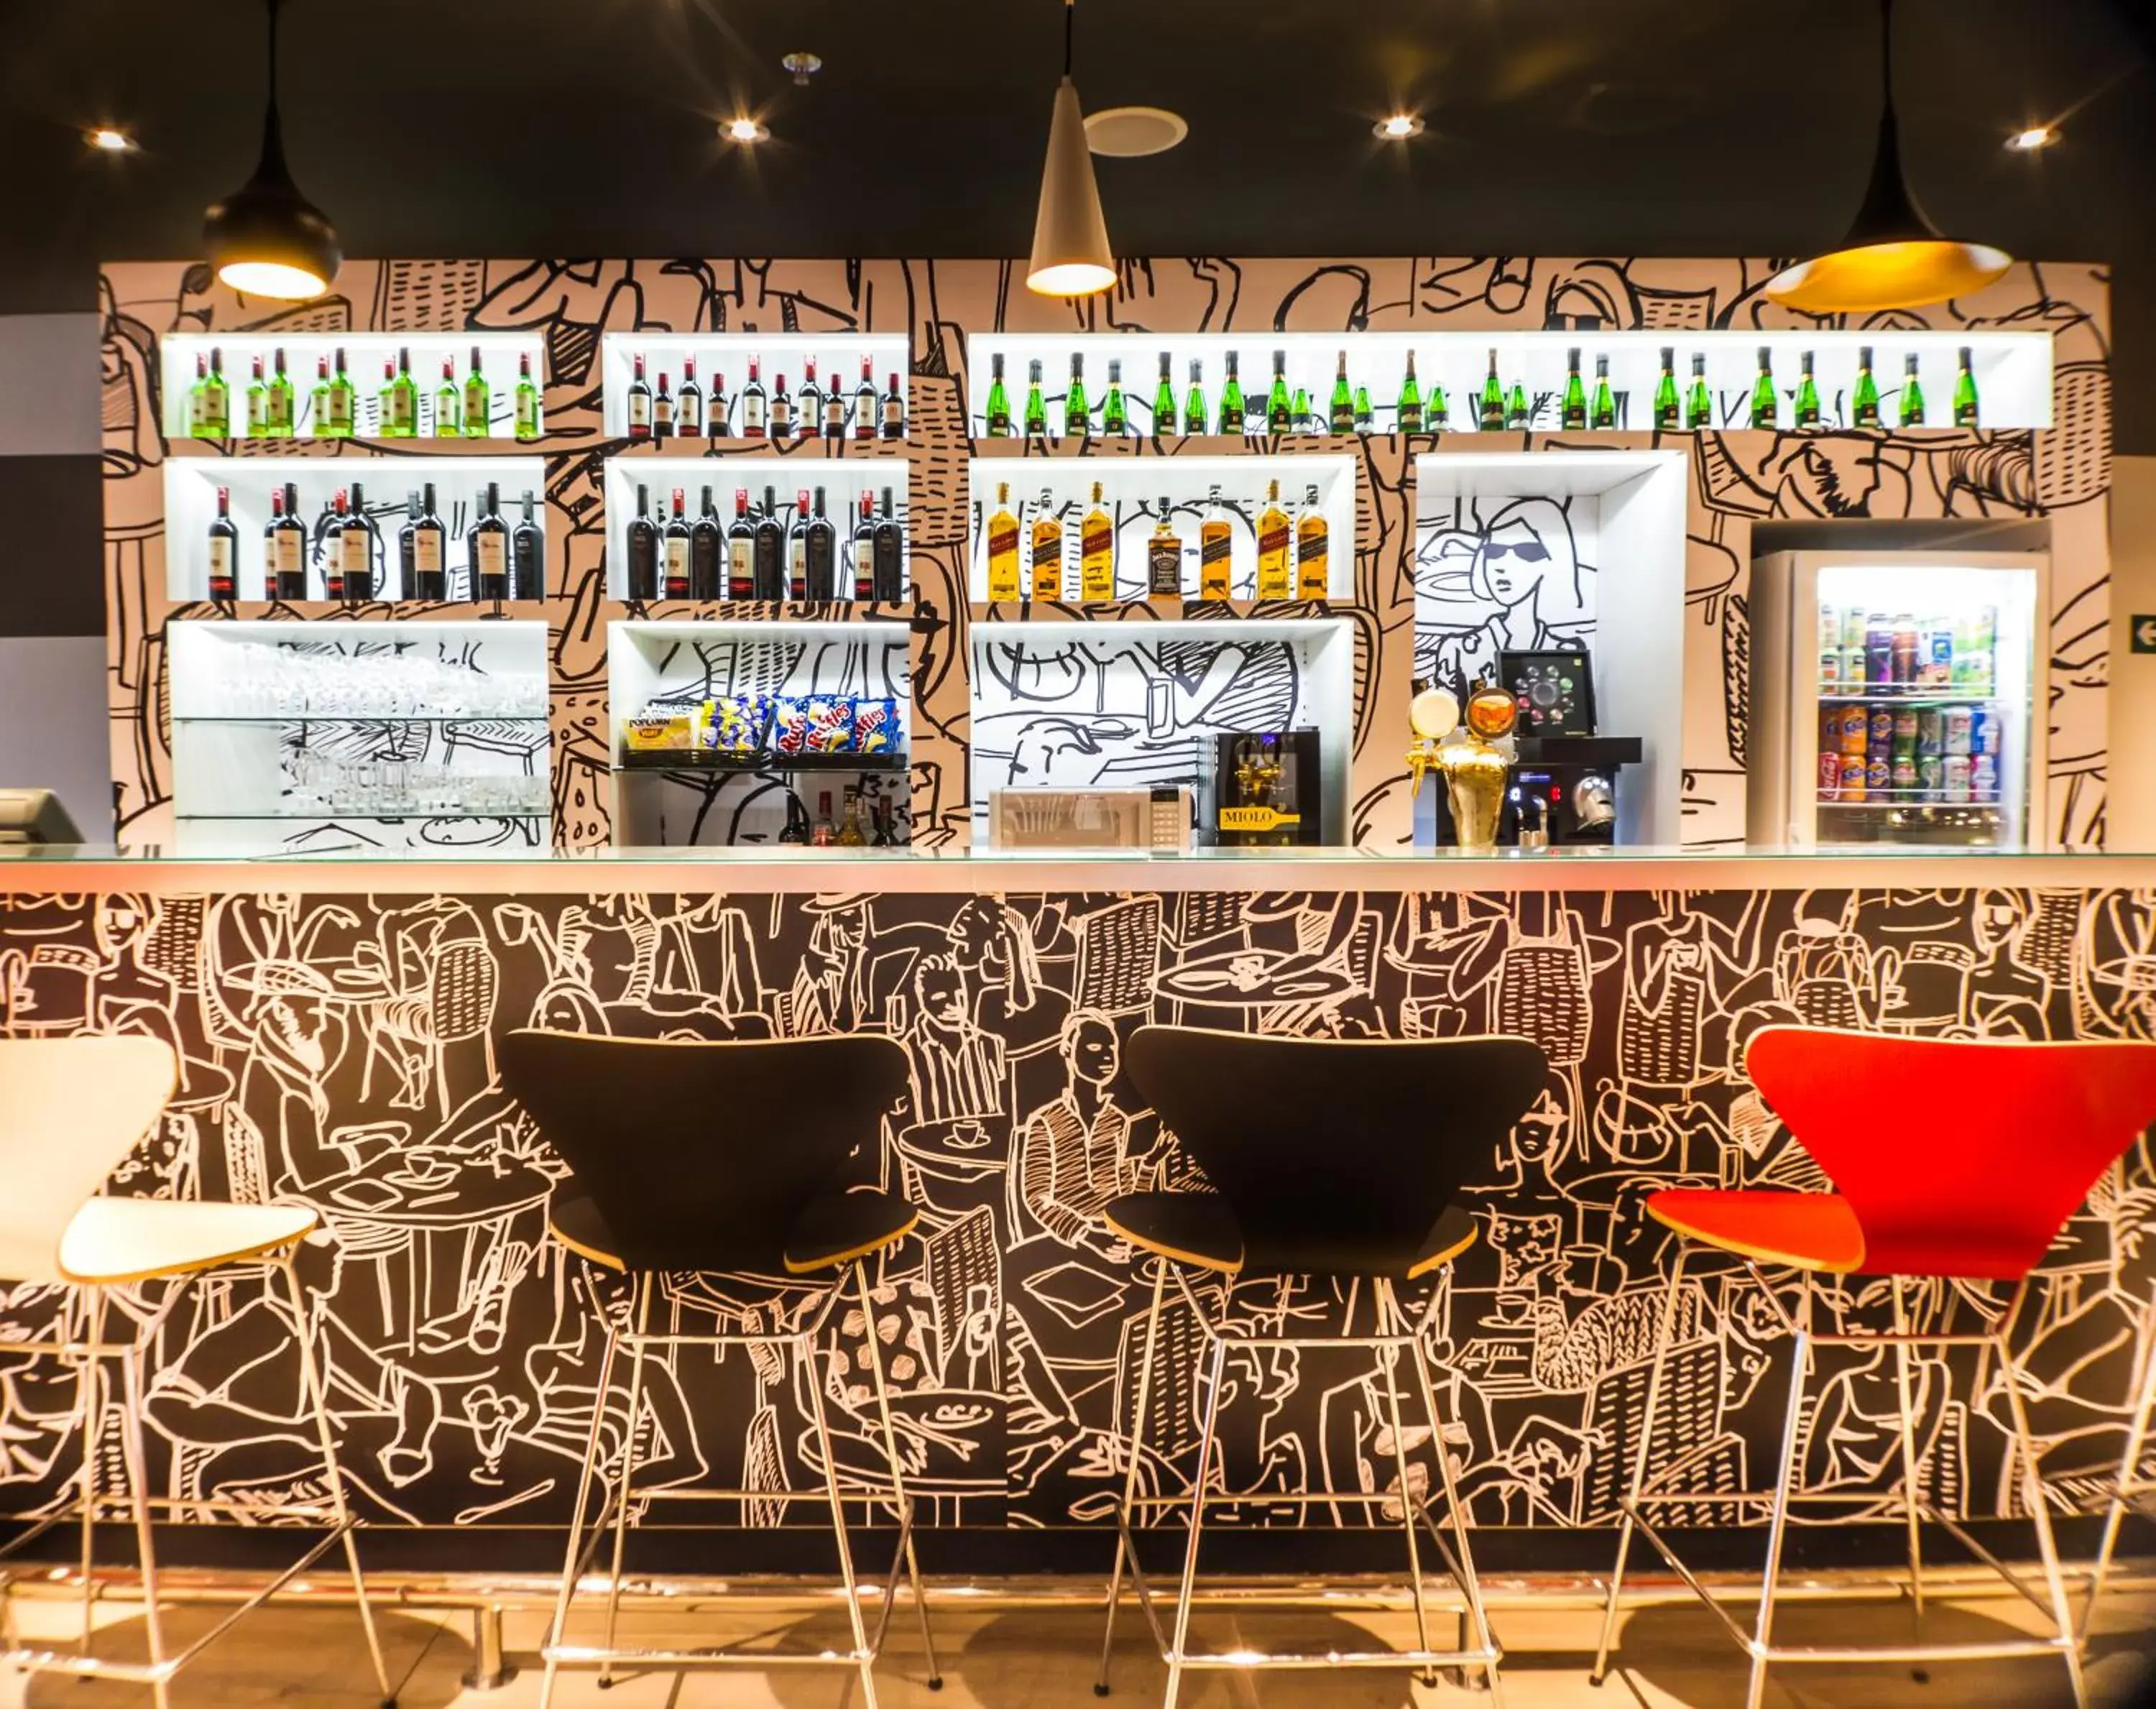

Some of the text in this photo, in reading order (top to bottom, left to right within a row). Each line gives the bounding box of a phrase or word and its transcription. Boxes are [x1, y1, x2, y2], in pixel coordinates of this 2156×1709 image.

[628, 718, 671, 728] POPCORN
[807, 703, 851, 750] Ruffles
[1225, 811, 1272, 822] MIOLO
